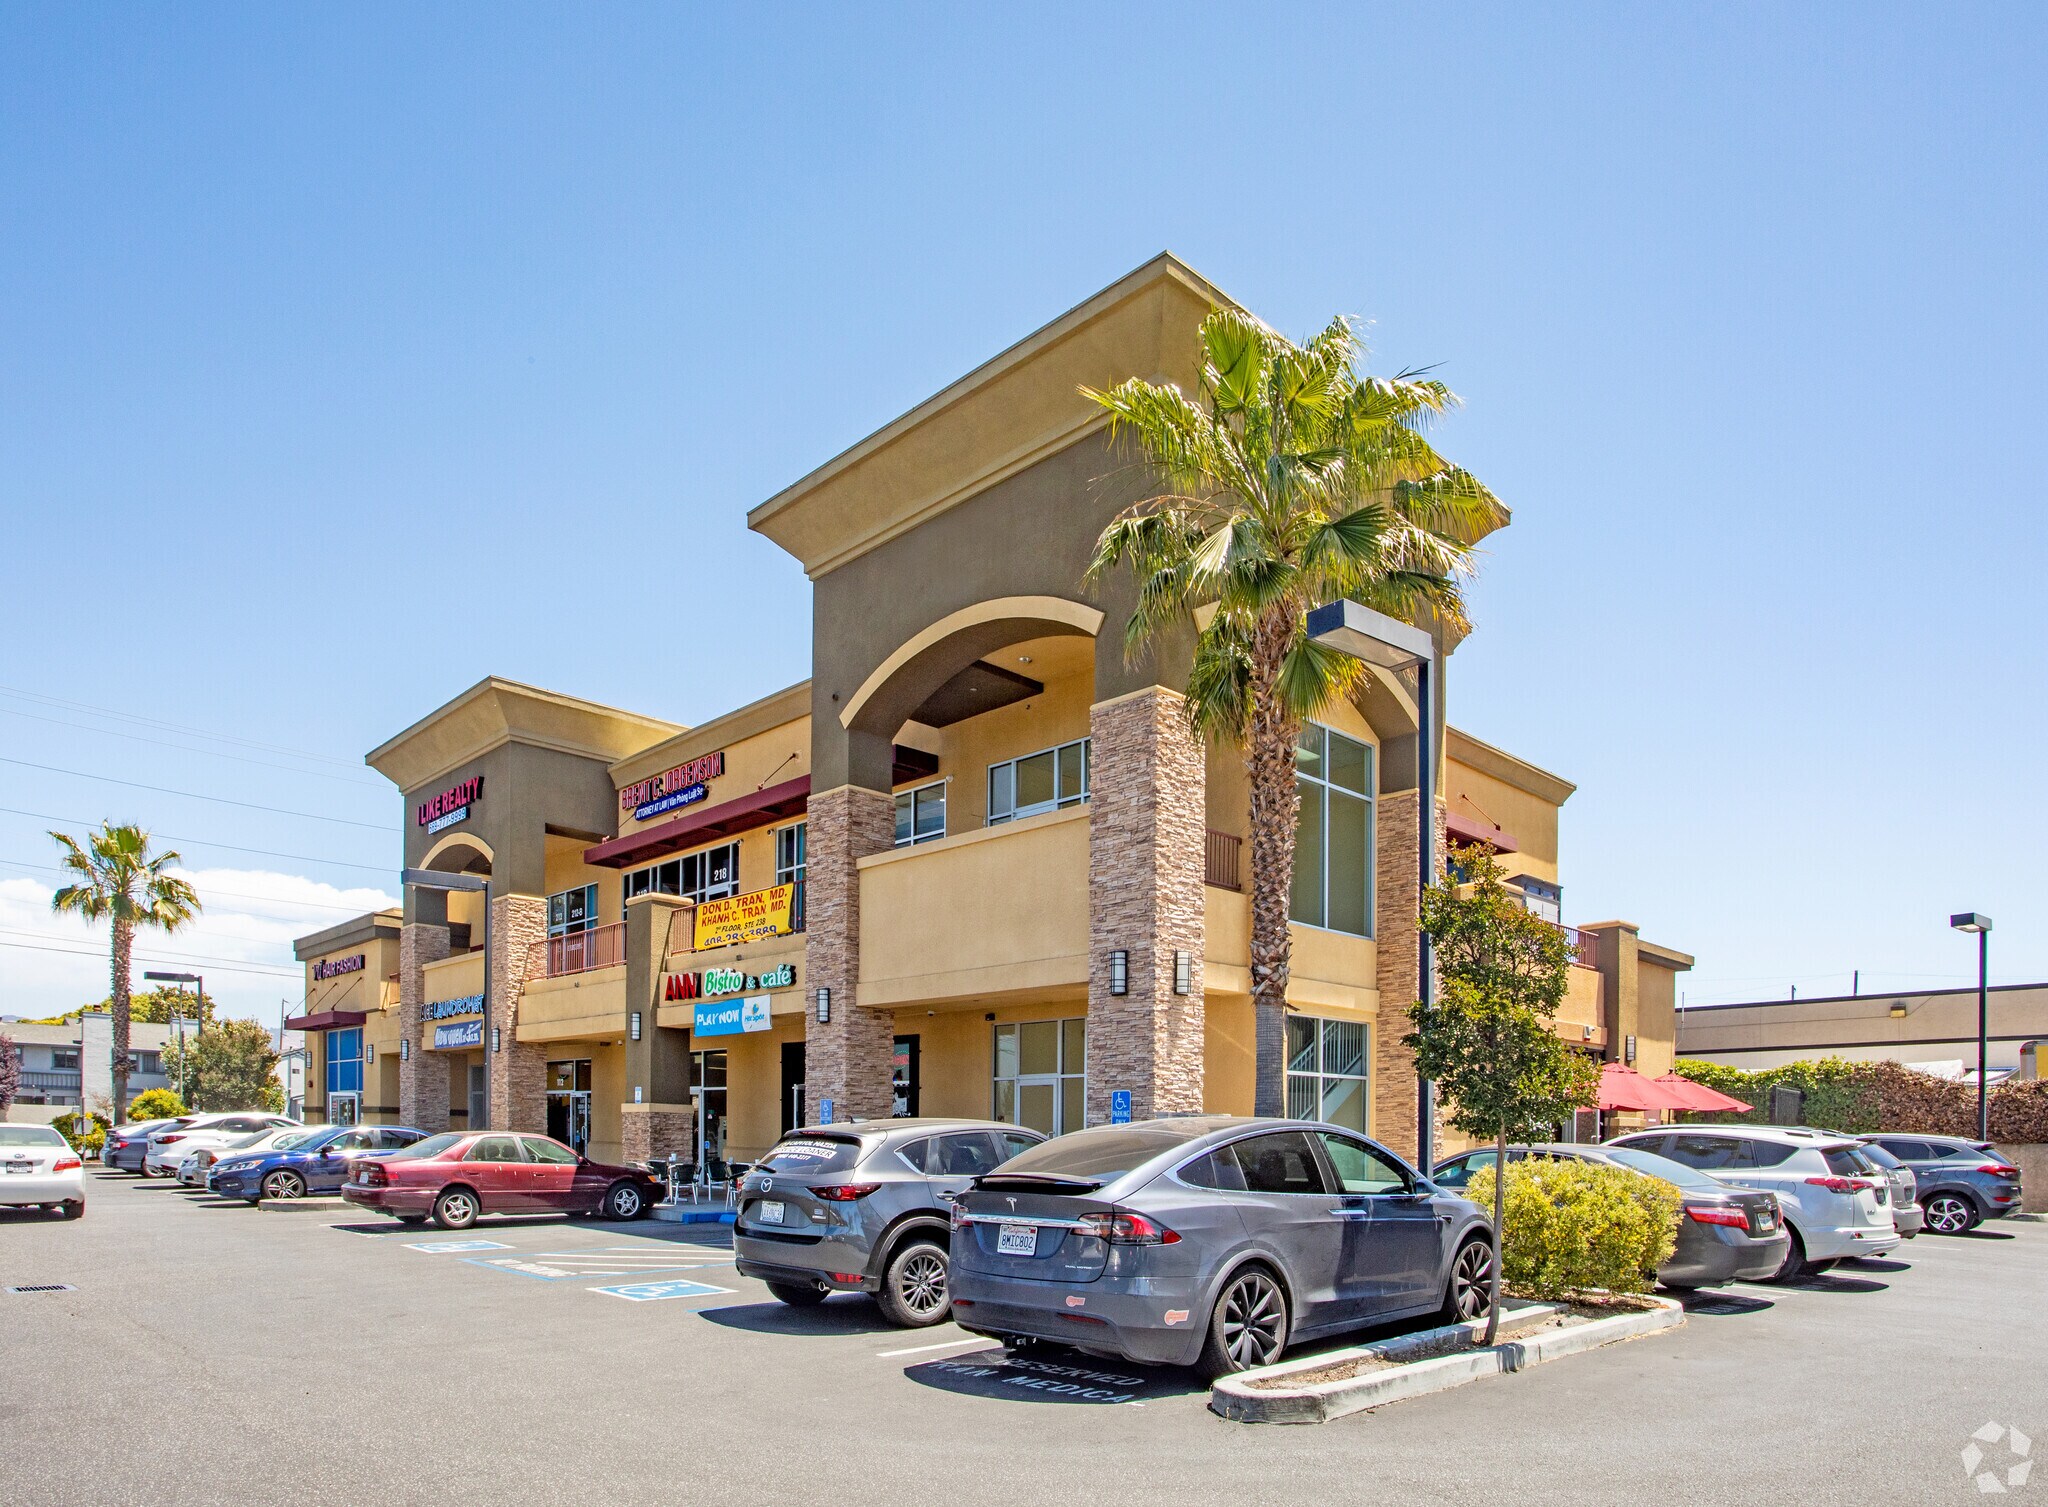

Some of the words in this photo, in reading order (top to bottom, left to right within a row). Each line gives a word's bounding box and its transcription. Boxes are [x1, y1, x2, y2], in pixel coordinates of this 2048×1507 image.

[622, 779, 652, 810] BRENT
[652, 776, 662, 798] C.
[662, 751, 721, 795] JORGENSON
[420, 796, 441, 825] LIKE
[441, 776, 480, 814] REALTY
[636, 804, 655, 819] ATTORNEY
[659, 801, 668, 811] LAW
[714, 867, 727, 881] 218
[701, 912, 730, 927] KHANH
[731, 911, 739, 921] C.
[771, 900, 786, 912] MD.
[702, 902, 722, 916] DON
[724, 901, 732, 911] D.
[769, 888, 787, 900] MD.
[744, 921, 754, 930] STE
[322, 962, 336, 979] HAIR
[336, 954, 362, 976] FASHION
[665, 972, 696, 1001] ANN
[704, 967, 743, 997] Bistro
[746, 976, 756, 990] &
[759, 964, 792, 989] café
[696, 1011, 719, 1027] PLAY
[719, 1009, 740, 1025] NOW
[799, 1147, 833, 1158] LOANER
[1001, 1233, 1034, 1249] 8MIC802
[1004, 1358, 1145, 1386] RESERVED
